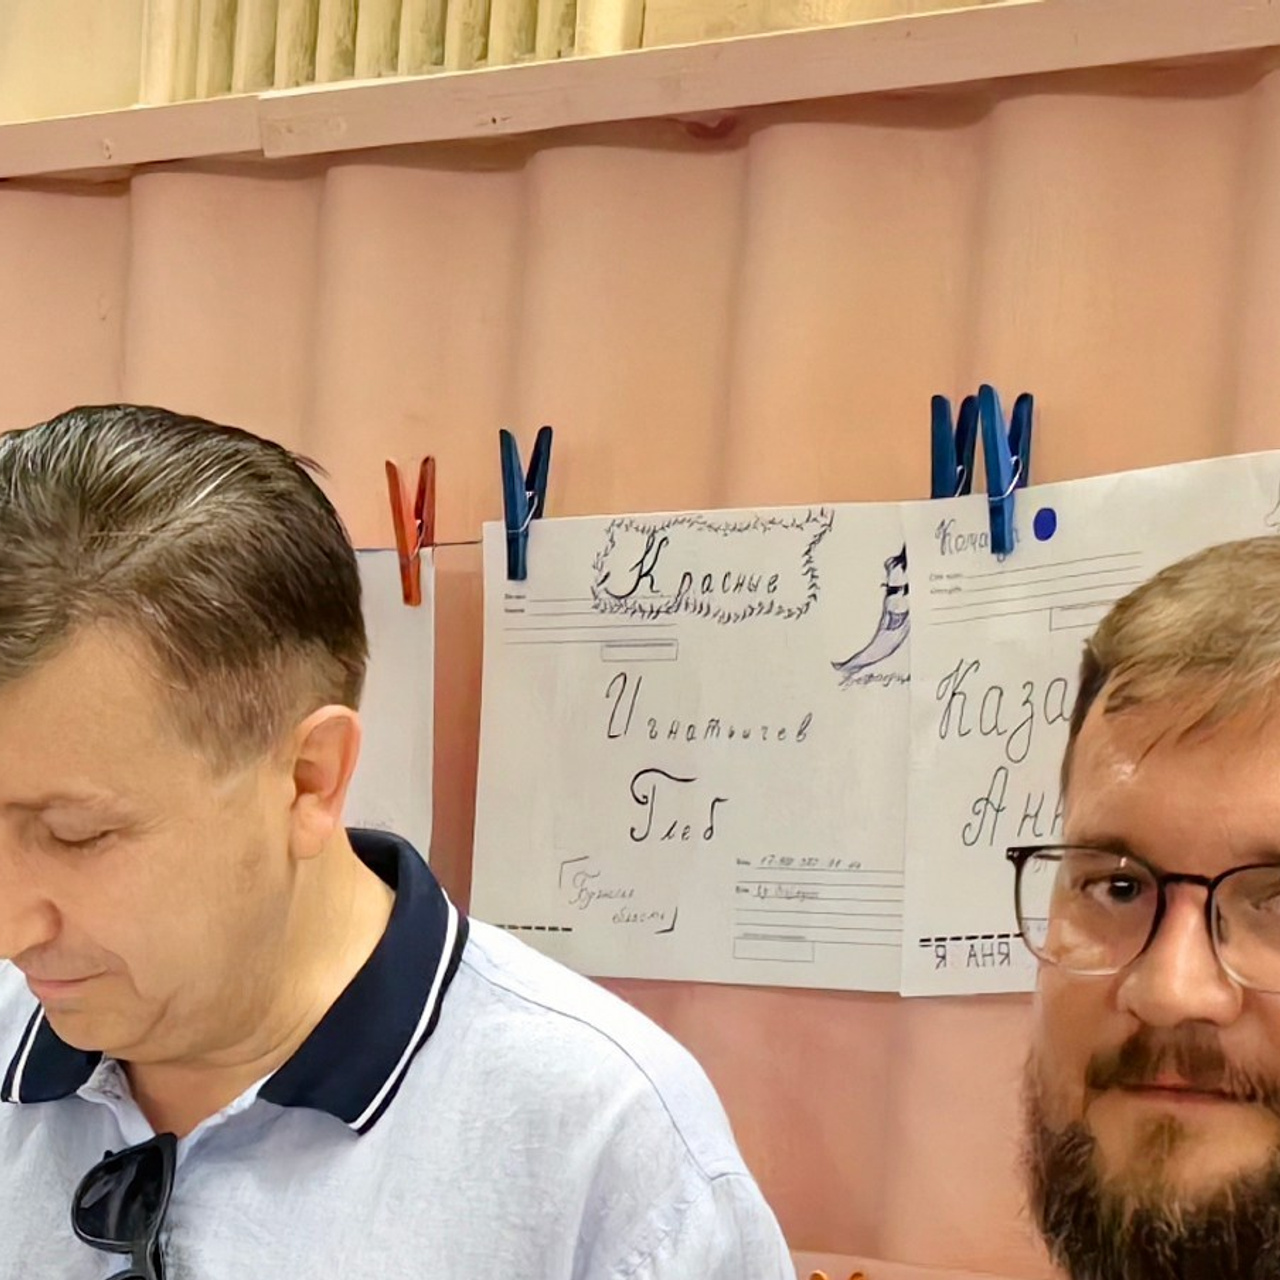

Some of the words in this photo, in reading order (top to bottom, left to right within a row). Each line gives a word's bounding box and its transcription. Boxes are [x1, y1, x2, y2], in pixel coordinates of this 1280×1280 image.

[935, 658, 1071, 764] Каза
[630, 767, 730, 843] Глеб
[935, 944, 947, 969] Я
[966, 941, 1011, 968] АНЯ
